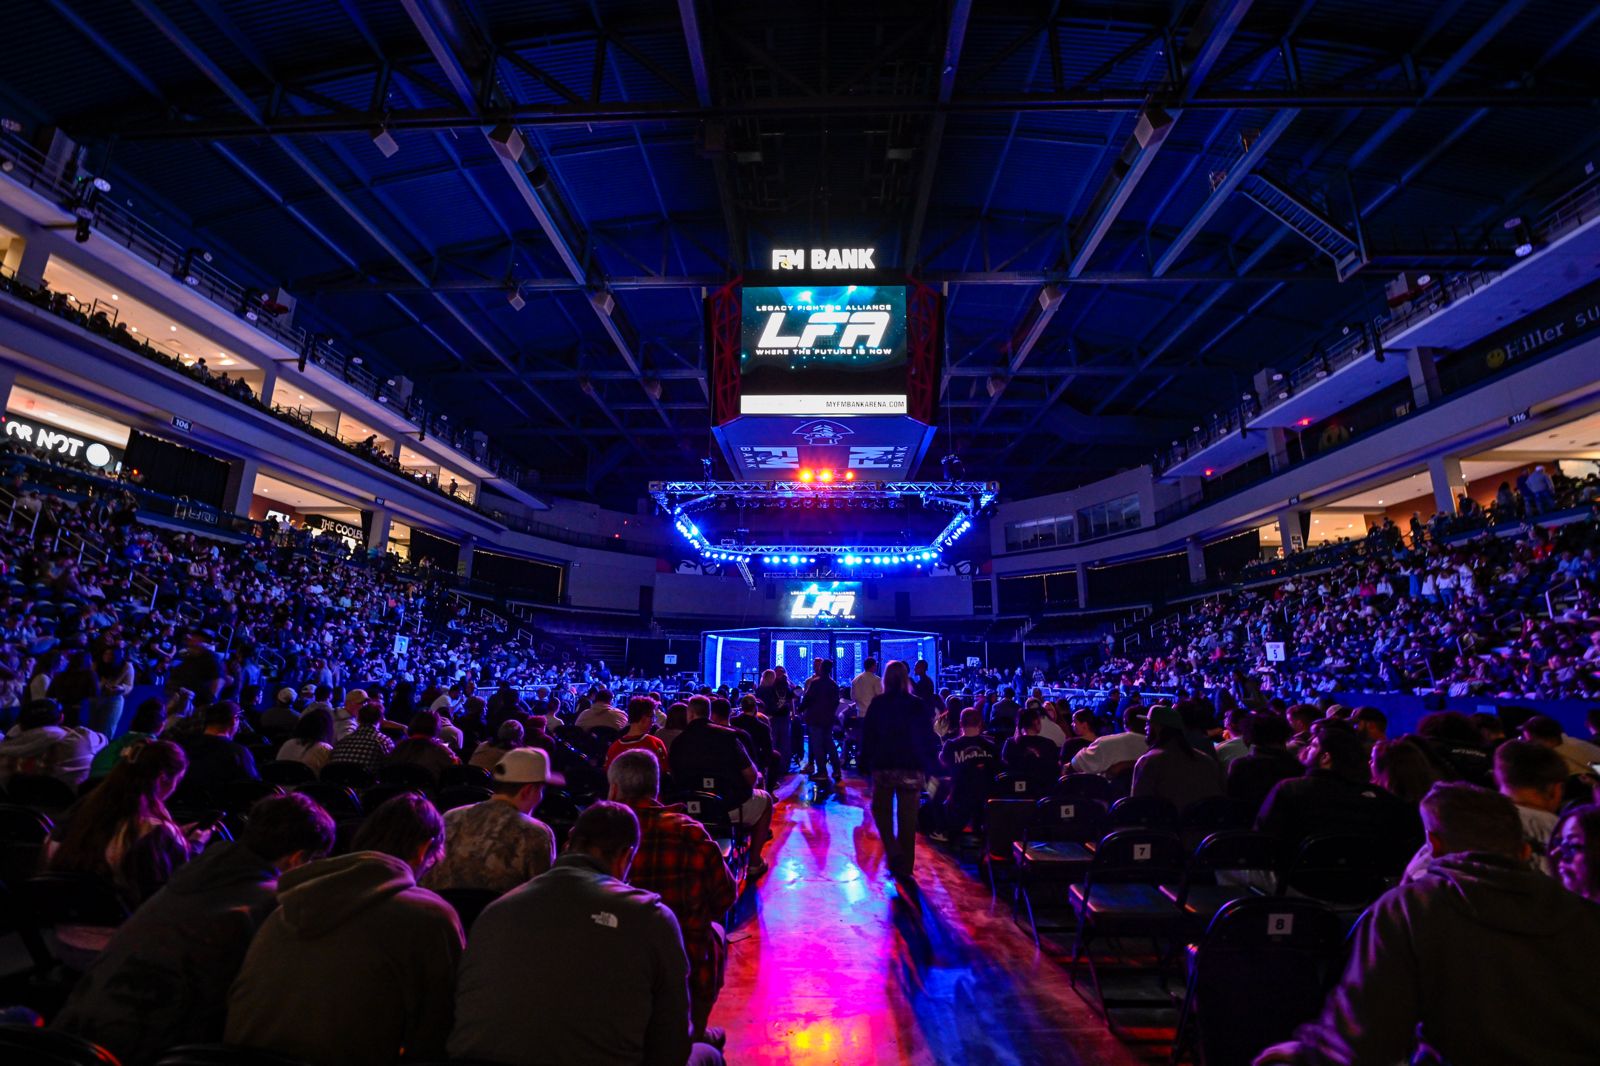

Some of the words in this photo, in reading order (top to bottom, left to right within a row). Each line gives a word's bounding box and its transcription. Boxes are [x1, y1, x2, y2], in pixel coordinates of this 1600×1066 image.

[811, 248, 876, 270] BANK
[757, 311, 890, 348] LFA
[1505, 322, 1565, 360] Hiller
[176, 419, 189, 430] 106
[36, 428, 84, 457] NOT
[321, 518, 335, 532] THE
[1138, 847, 1145, 856] 7
[1275, 918, 1285, 930] 8
